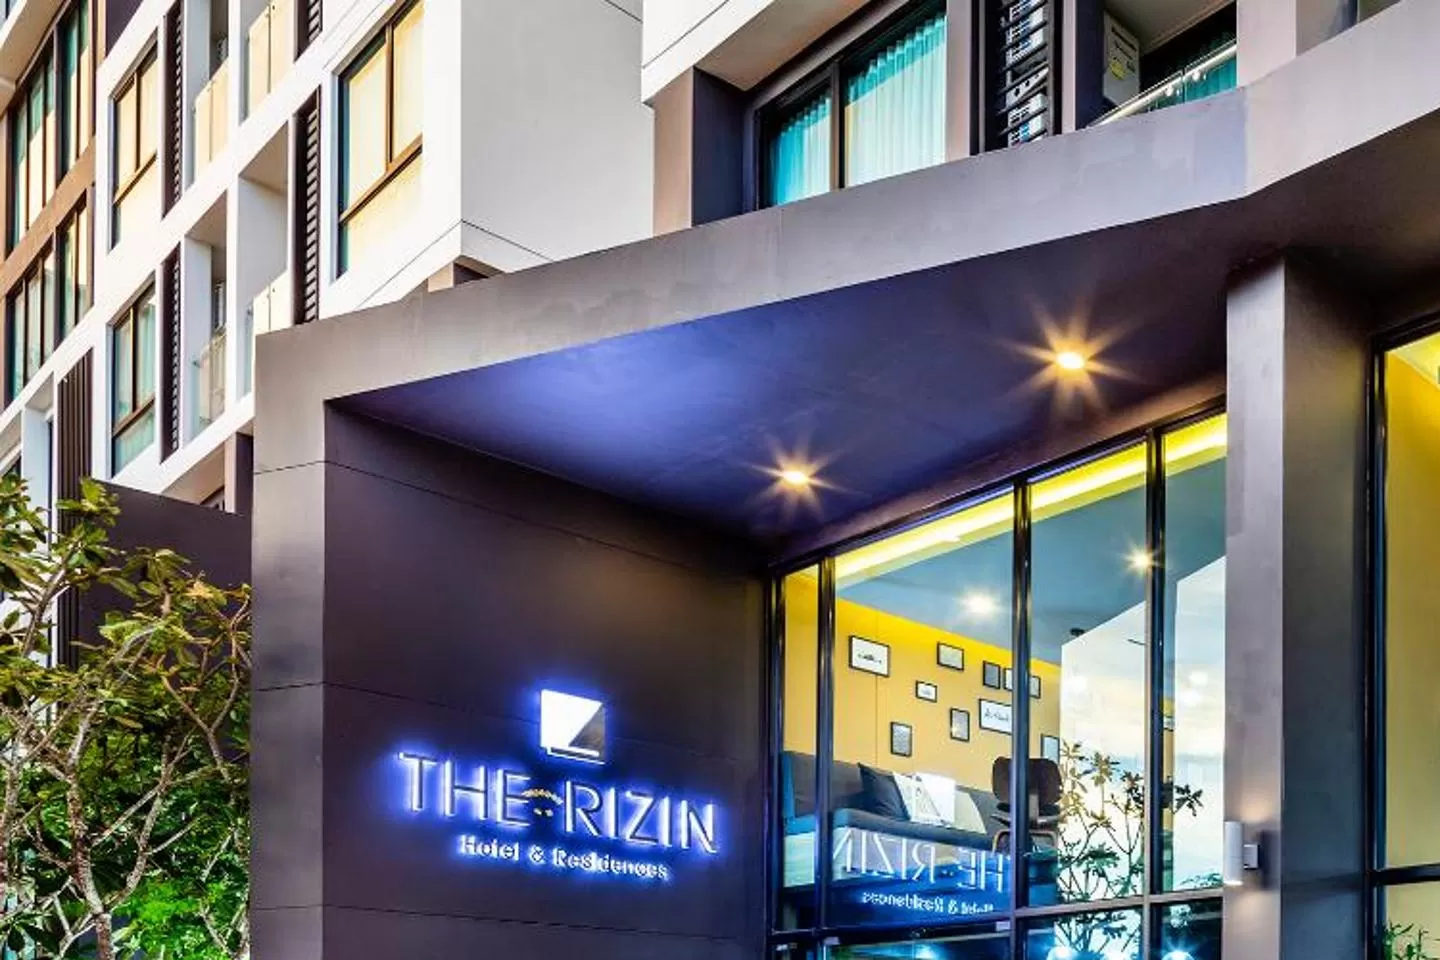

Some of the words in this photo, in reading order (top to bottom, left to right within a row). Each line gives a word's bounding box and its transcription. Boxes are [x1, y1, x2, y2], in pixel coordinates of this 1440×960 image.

[398, 751, 531, 827] THE
[564, 779, 719, 854] RIZIN
[459, 834, 520, 862] Hotel
[530, 843, 545, 865] &
[552, 848, 670, 882] Residences
